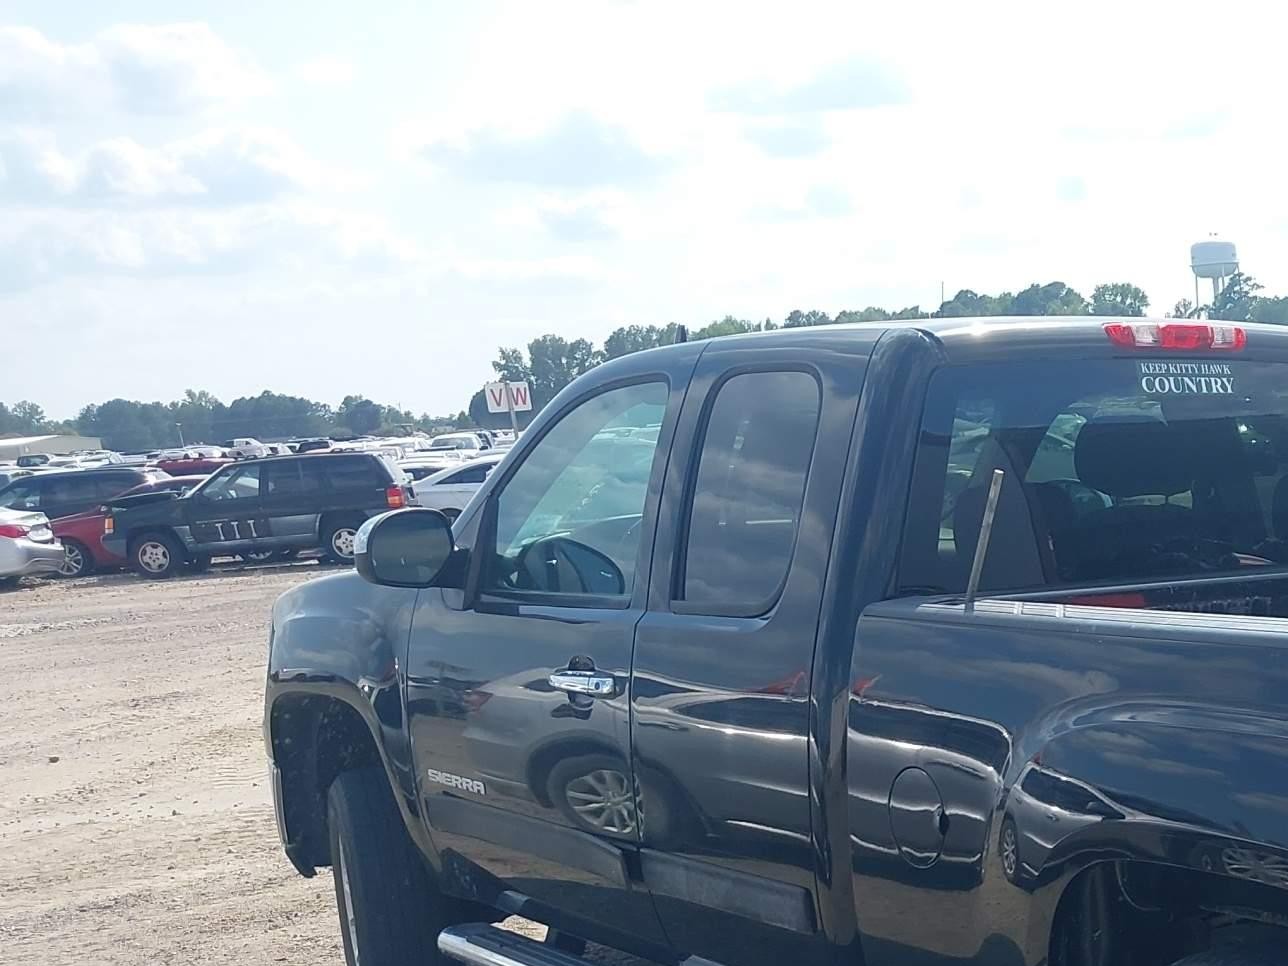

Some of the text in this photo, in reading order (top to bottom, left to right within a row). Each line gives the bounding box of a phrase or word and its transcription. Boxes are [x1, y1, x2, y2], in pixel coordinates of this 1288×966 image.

[1141, 362, 1232, 375] KEEP KITTY HAWK
[1141, 376, 1235, 393] COUNTRY
[427, 768, 486, 796] SIERRA
